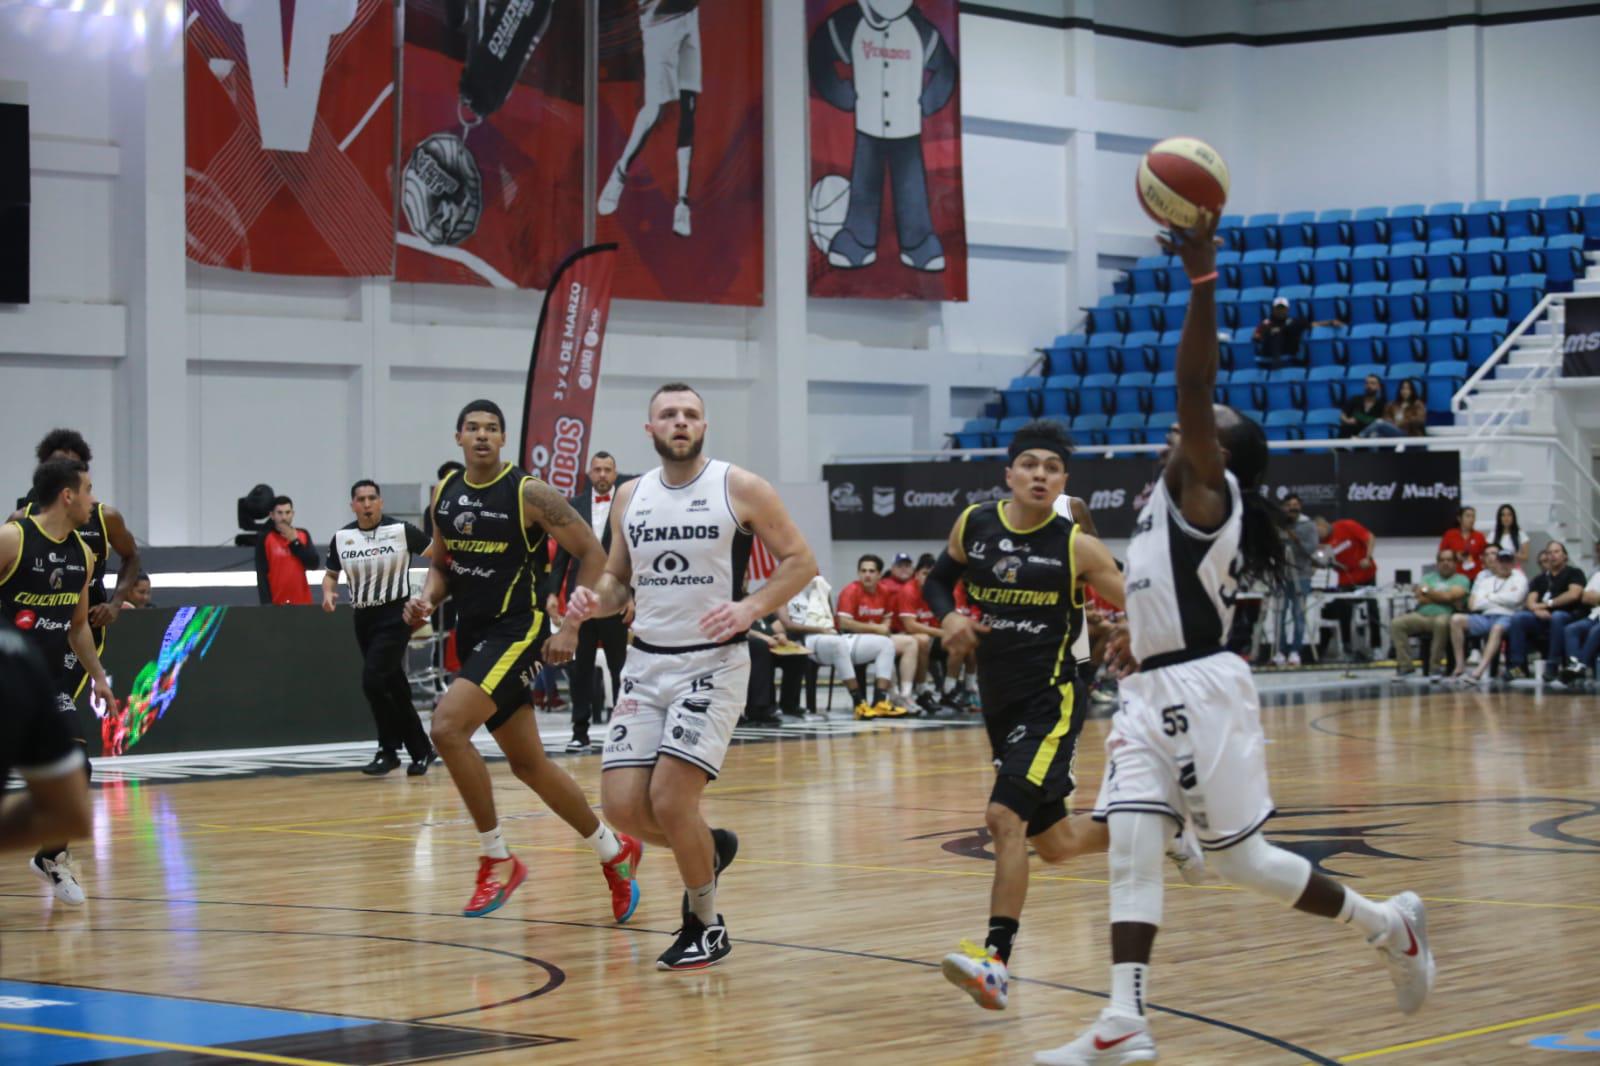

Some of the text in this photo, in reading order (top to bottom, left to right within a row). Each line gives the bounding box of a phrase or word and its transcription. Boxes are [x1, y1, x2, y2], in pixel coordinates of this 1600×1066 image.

[563, 282, 581, 337] MARZO
[560, 341, 573, 362] DE
[558, 365, 569, 376] 4
[553, 391, 563, 400] 3
[903, 488, 960, 508] Comex
[1348, 482, 1397, 501] telcel
[628, 520, 720, 548] VENADOS
[341, 545, 395, 560] CIBACOPA
[670, 574, 715, 586] Azteca
[691, 674, 714, 693] 15
[1162, 703, 1188, 737] 55
